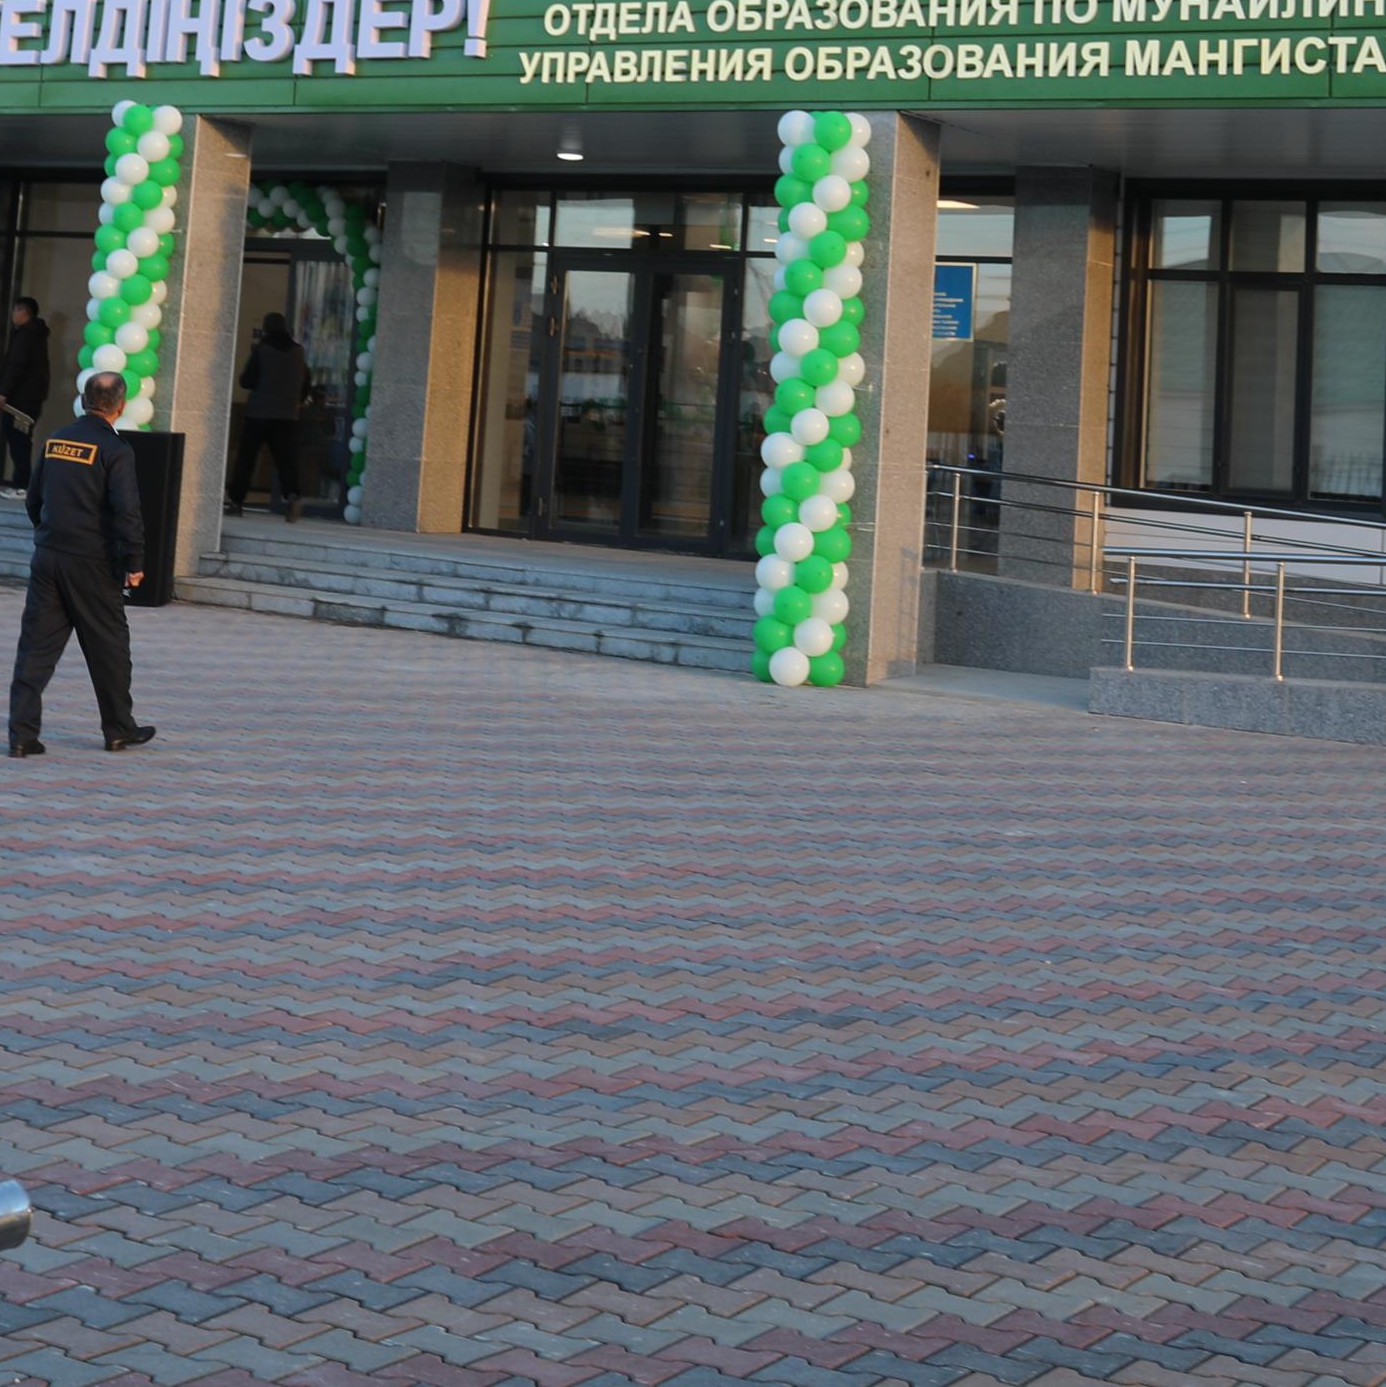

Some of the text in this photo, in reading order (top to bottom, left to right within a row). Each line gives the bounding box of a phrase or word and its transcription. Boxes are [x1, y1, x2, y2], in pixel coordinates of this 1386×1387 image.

[544, 0, 696, 42] ОТДЕЛА
[519, 46, 774, 85] УПРАВЛЕНИЯ
[784, 41, 1110, 82] ОБРАЗОВАНИЯ
